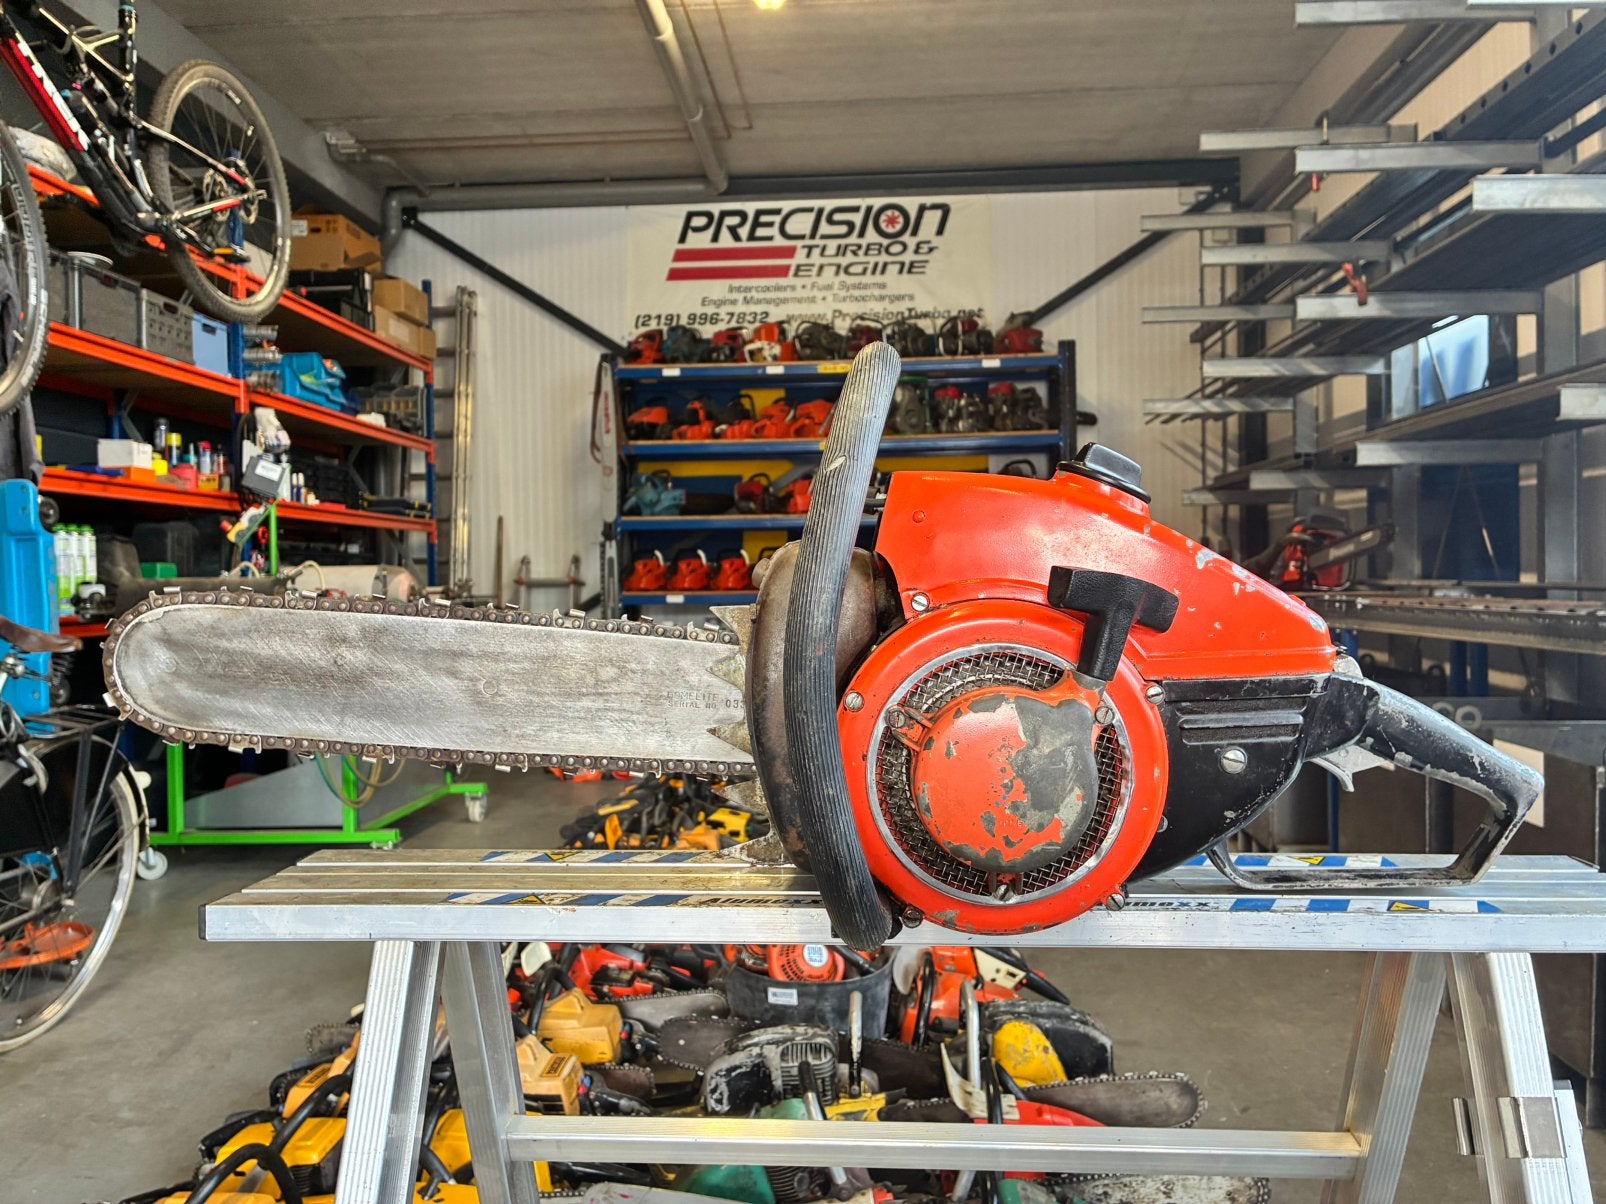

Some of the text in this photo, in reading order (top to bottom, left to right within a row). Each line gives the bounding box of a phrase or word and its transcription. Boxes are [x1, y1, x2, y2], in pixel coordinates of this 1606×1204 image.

[801, 240, 939, 259] TURBO &
[728, 281, 888, 295] Intercoolers Fuel Systems
[701, 292, 915, 309] Engine Management Turbochargers
[634, 313, 681, 329] (219)
[687, 311, 770, 326] 996-7832
